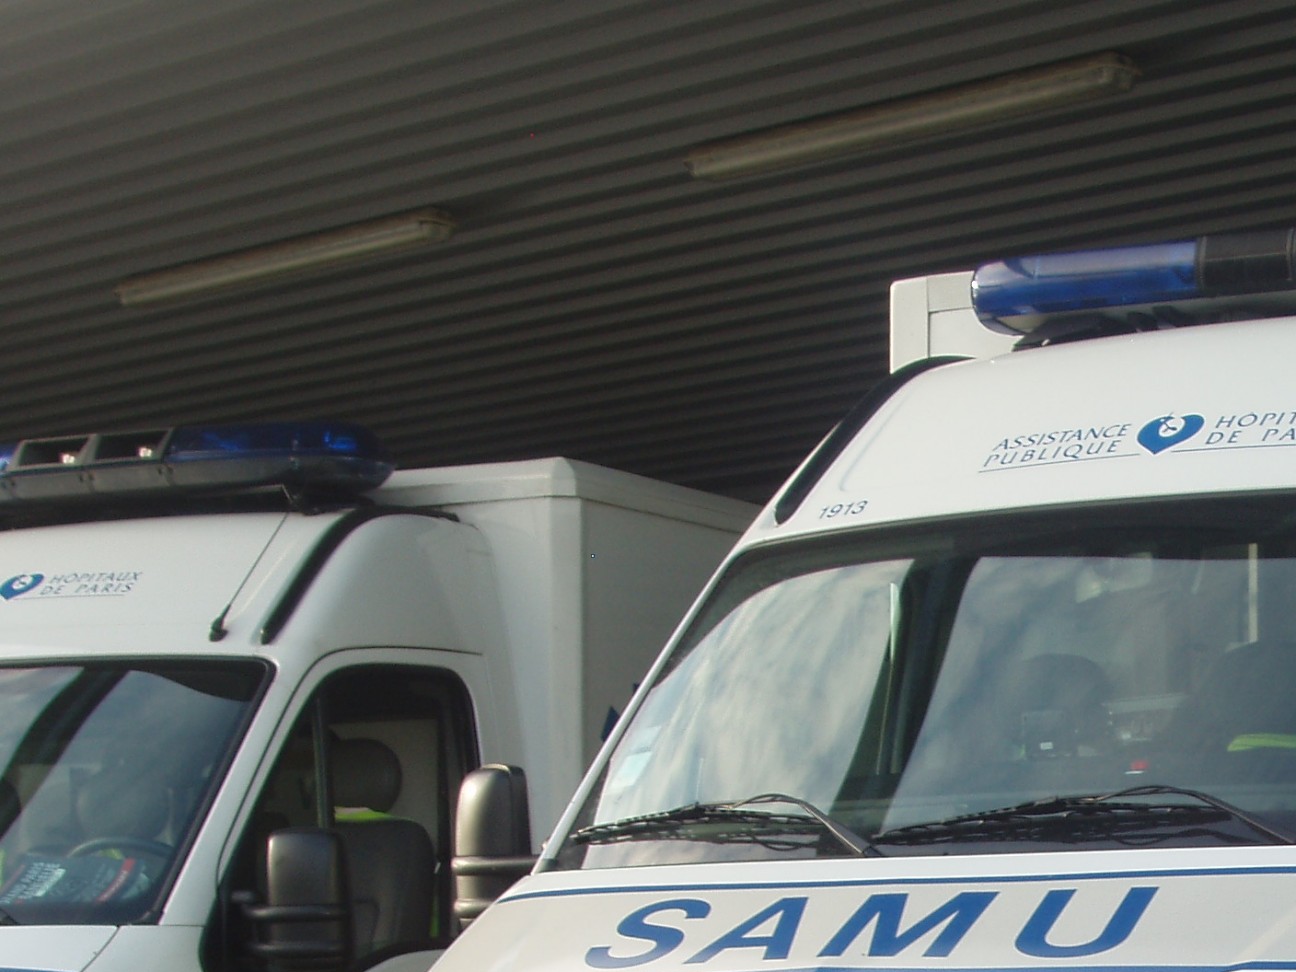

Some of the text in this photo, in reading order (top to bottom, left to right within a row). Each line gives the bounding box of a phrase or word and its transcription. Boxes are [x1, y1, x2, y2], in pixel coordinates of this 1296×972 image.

[983, 440, 1122, 468] PUBLIQUE
[1205, 430, 1242, 445] DE
[992, 423, 1132, 451] ASSISTANCE
[819, 500, 868, 519] 1913
[40, 583, 134, 596] DE PARIS
[585, 886, 1160, 970] SAMU
